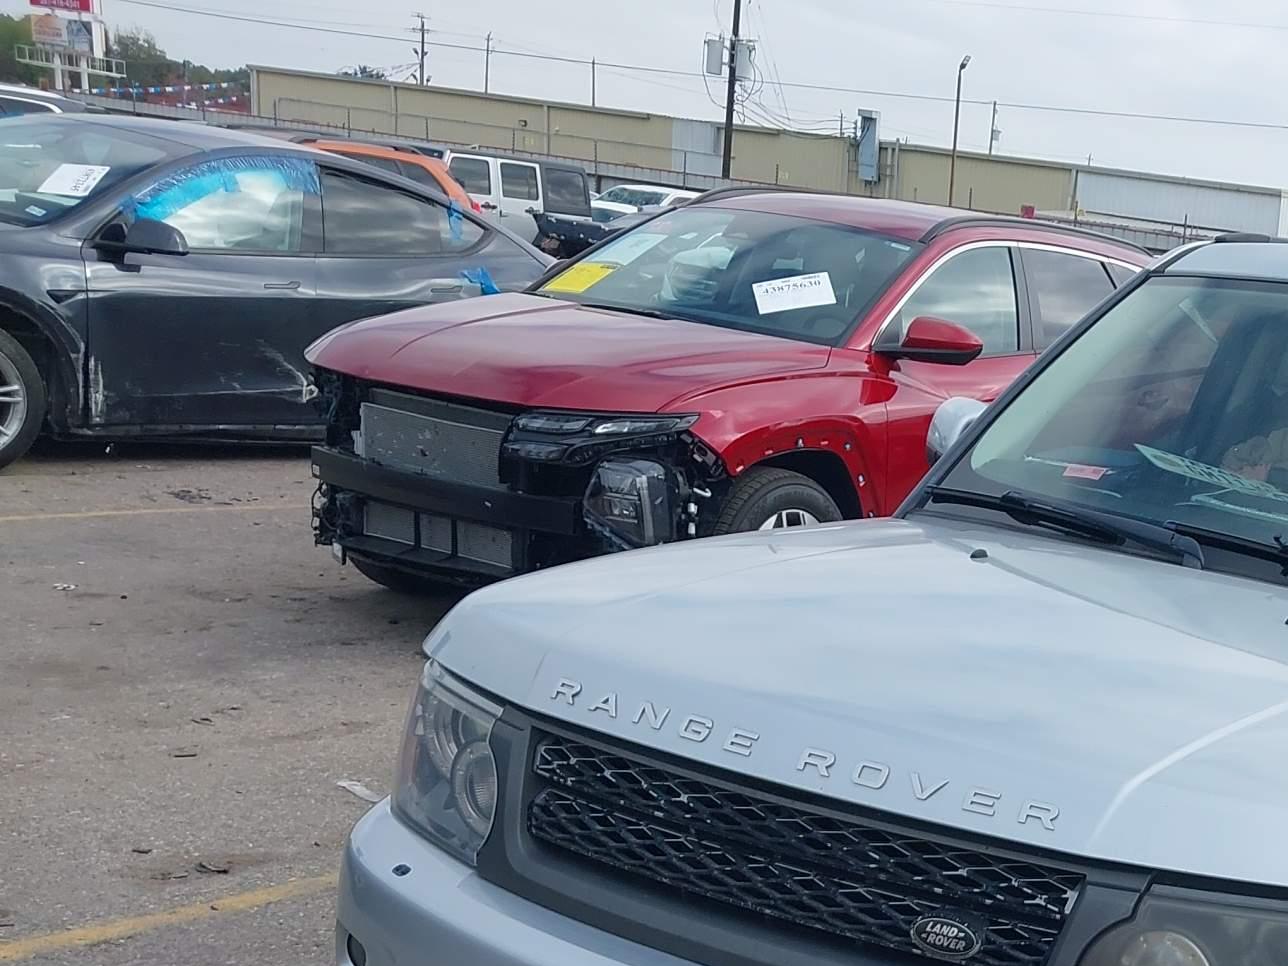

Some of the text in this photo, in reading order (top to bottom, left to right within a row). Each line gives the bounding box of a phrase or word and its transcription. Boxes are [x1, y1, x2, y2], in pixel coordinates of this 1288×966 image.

[549, 676, 1062, 832] RANGE ROVER
[925, 921, 959, 937] LAND
[926, 932, 967, 951] ROVER
